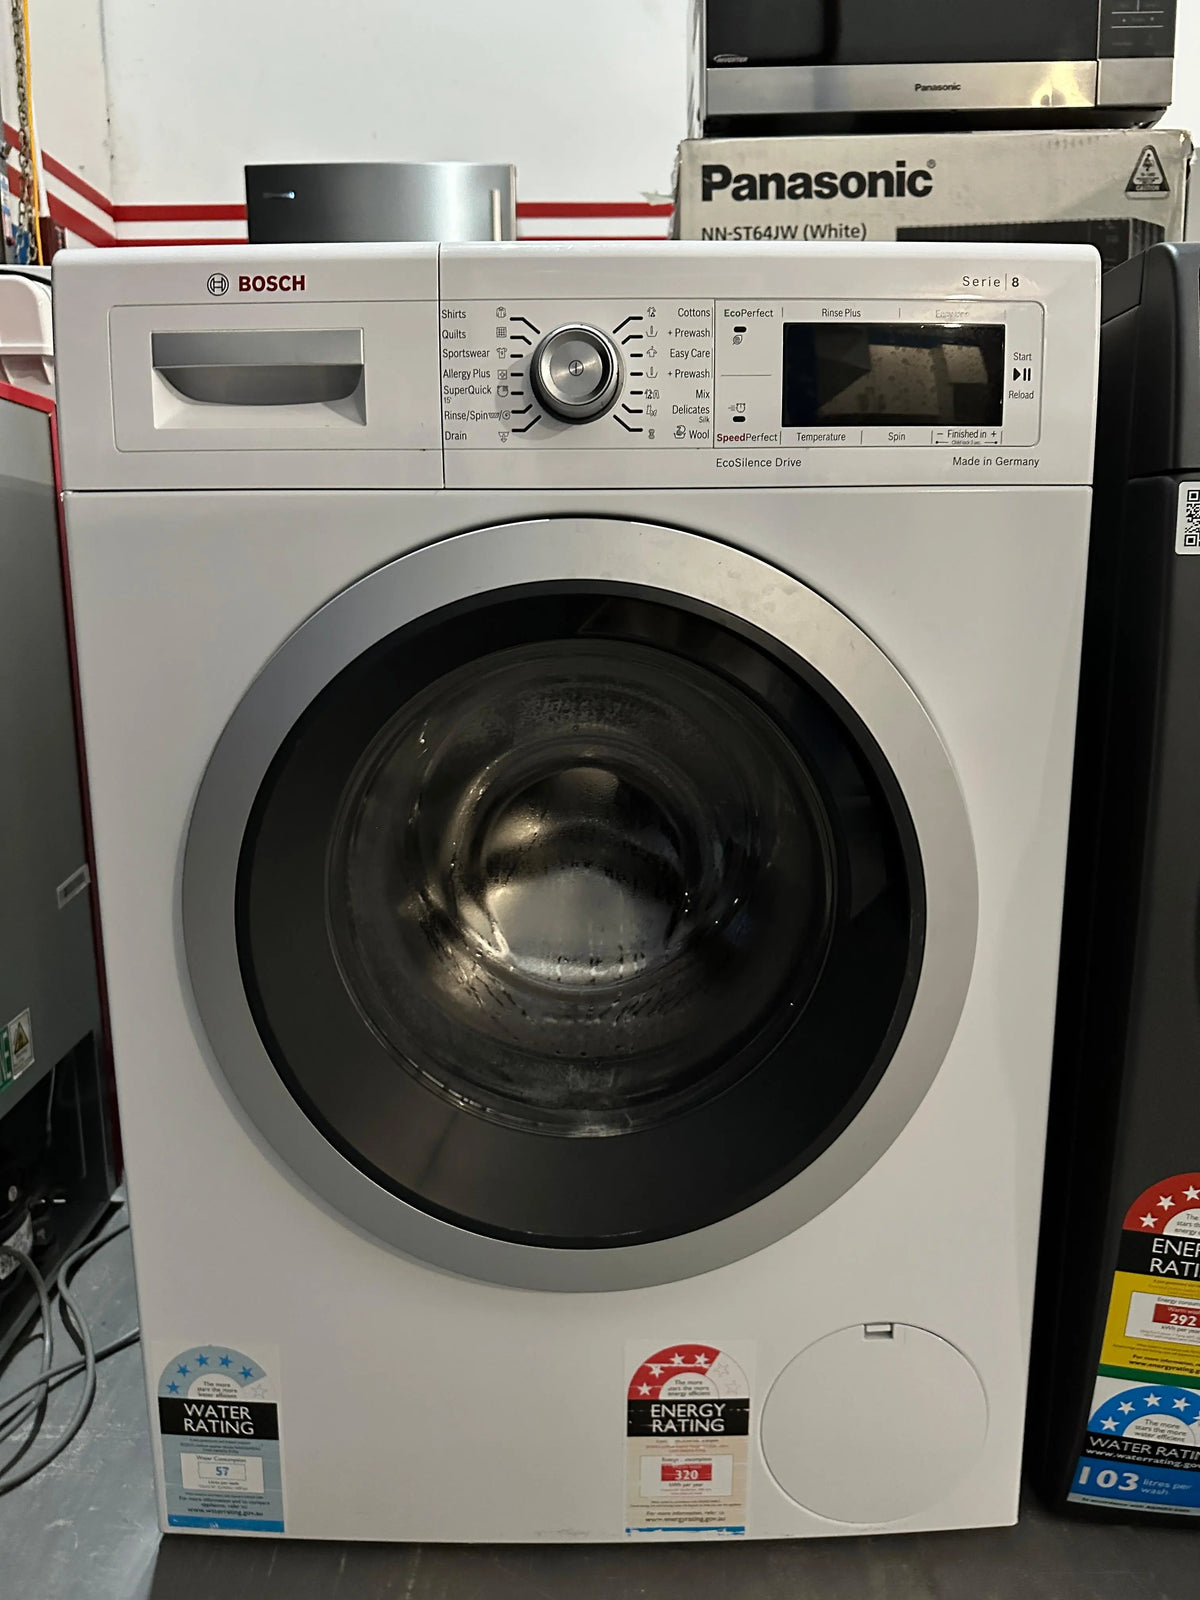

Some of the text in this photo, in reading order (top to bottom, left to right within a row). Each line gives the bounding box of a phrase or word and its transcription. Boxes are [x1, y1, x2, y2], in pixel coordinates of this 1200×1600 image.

[914, 82, 961, 92] Panasonic
[702, 160, 933, 202] Panasonic
[702, 222, 867, 241] NN-ST64JW (White)
[238, 274, 305, 292] BOSCH
[962, 276, 1020, 288] Serie 8
[442, 309, 467, 319] Shirts
[678, 308, 710, 318] Cottons
[724, 308, 774, 318] EcoPerfect
[822, 308, 862, 317] Rinse Plus
[442, 329, 466, 339] Quilts
[675, 328, 710, 338] Prewash
[442, 348, 490, 360] Sportswear
[670, 348, 710, 359] Easy Care
[1013, 352, 1032, 361] Start
[443, 368, 490, 380] Allergy Plus
[675, 369, 710, 378] Prewash
[444, 385, 492, 396] SuperQuick
[696, 389, 710, 399] Mix
[1008, 390, 1034, 399] Reload
[672, 404, 710, 414] Delicates
[444, 410, 488, 421] Rinse/Spin
[445, 431, 467, 440] Drain
[689, 429, 710, 439] Wool
[716, 432, 778, 443] SpeedPerfect
[797, 432, 846, 442] Temperature
[888, 432, 906, 442] Spin
[947, 430, 979, 438] Finished
[980, 430, 987, 438] in
[716, 457, 802, 468] EcoSilence Drive
[952, 456, 1040, 468] Made in Germany
[1170, 1313, 1197, 1326] 292
[184, 1403, 252, 1420] WATER
[651, 1403, 726, 1418] ENERGY
[184, 1418, 254, 1435] RATING
[652, 1418, 725, 1433] RATING
[1090, 1436, 1152, 1454] WATER
[216, 1466, 230, 1476] 57
[675, 1470, 699, 1480] 320
[1078, 1466, 1140, 1491] 103
[1143, 1479, 1170, 1488] litres
[1141, 1487, 1169, 1495] wash
